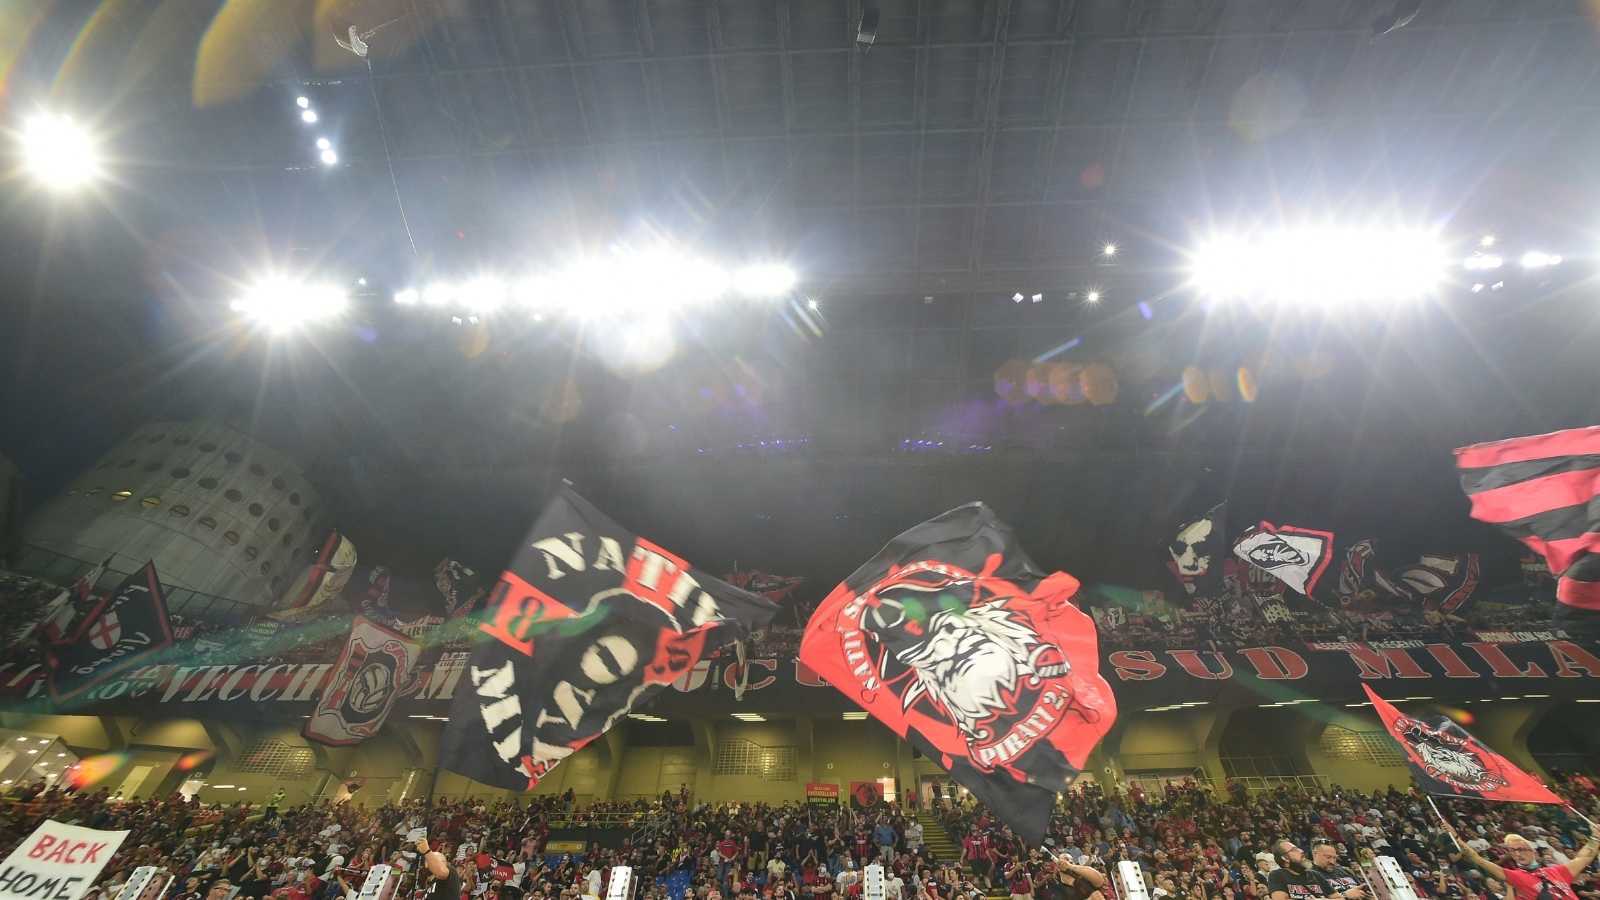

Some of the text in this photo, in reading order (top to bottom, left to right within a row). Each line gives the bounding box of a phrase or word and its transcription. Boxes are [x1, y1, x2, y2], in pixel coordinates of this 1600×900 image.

[1108, 647, 1308, 680] SUD
[978, 705, 1056, 769] PIRATI
[27, 834, 108, 864] BACK
[0, 866, 84, 900] HOME
